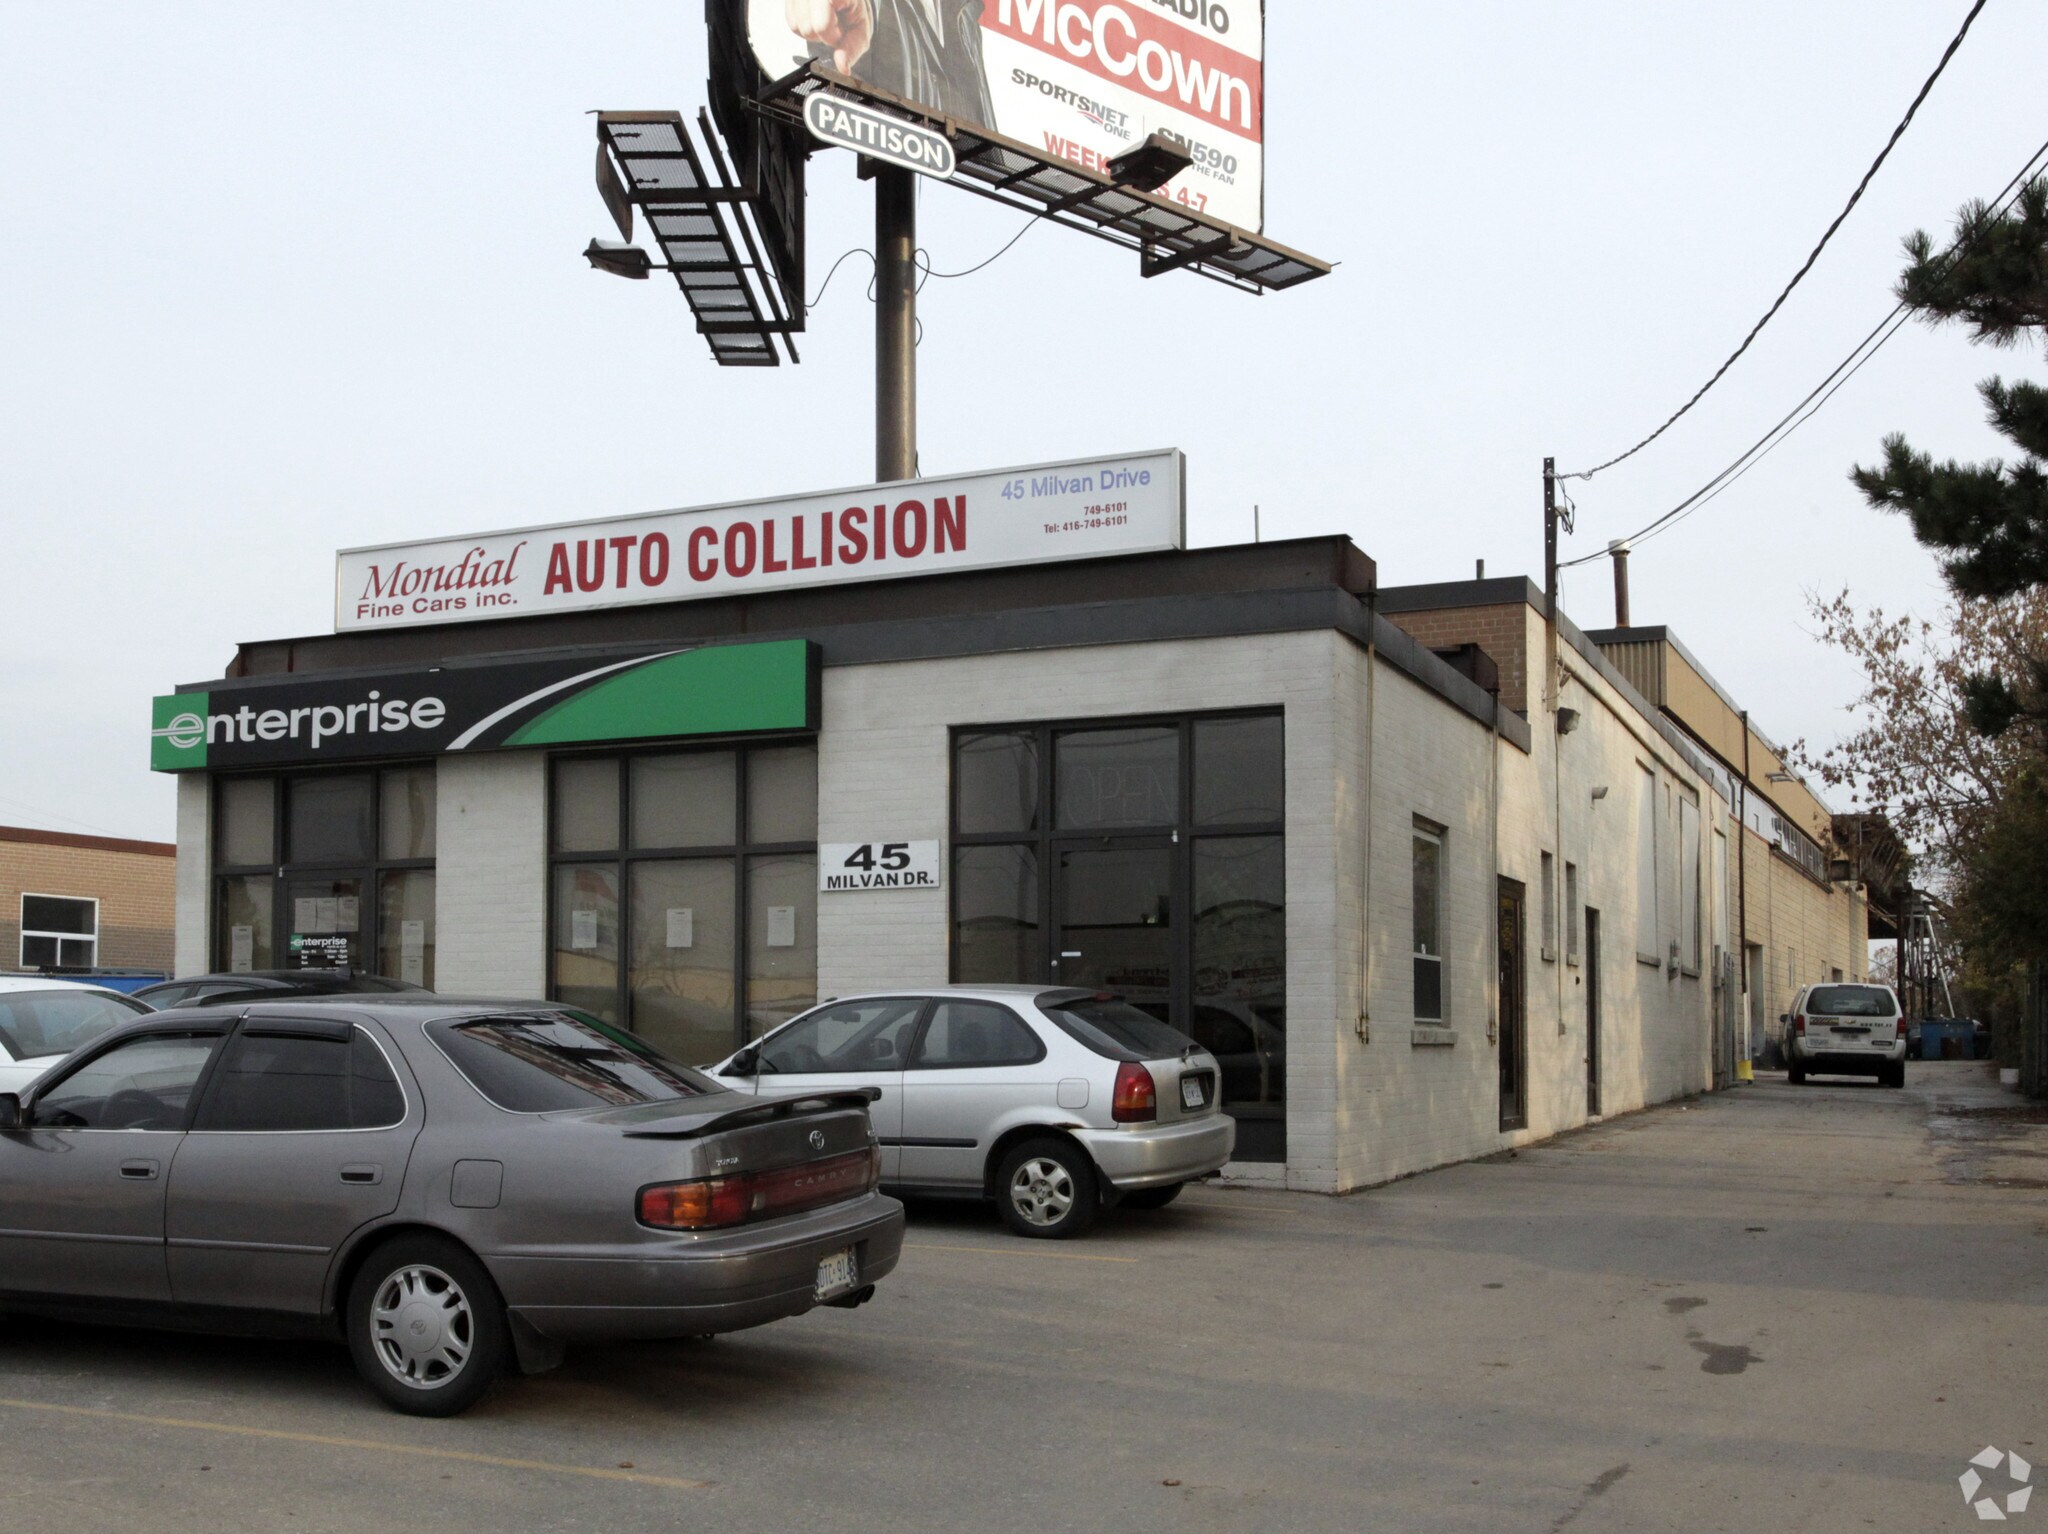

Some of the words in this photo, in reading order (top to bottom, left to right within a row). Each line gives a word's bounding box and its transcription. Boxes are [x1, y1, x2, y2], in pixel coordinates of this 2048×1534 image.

[998, 0, 1251, 130] McCown
[1011, 67, 1129, 128] SPORTSNET
[818, 102, 943, 169] PATTISON
[1103, 123, 1131, 141] ONE
[1191, 162, 1211, 177] THE
[1212, 171, 1235, 186] FAN
[1176, 186, 1208, 213] 4-7
[1001, 480, 1025, 500] 45
[1031, 475, 1093, 498] Milvan
[1100, 467, 1151, 490] Drive
[1083, 501, 1128, 516] 749-6101
[1044, 523, 1060, 534] Tel:
[1062, 514, 1128, 532] 416-749-6101
[543, 531, 670, 596] AUTO
[688, 494, 967, 583] COLLISION
[358, 541, 528, 601] Mondial
[356, 603, 405, 620] Fine
[412, 596, 467, 614] Cars
[476, 592, 518, 608] inc.
[154, 690, 446, 749] enterprise
[844, 842, 911, 872] 45
[827, 872, 899, 889] MILVAN
[903, 870, 935, 885] DR.
[290, 936, 347, 948] enterprise
[794, 1168, 848, 1187] CAMRY
